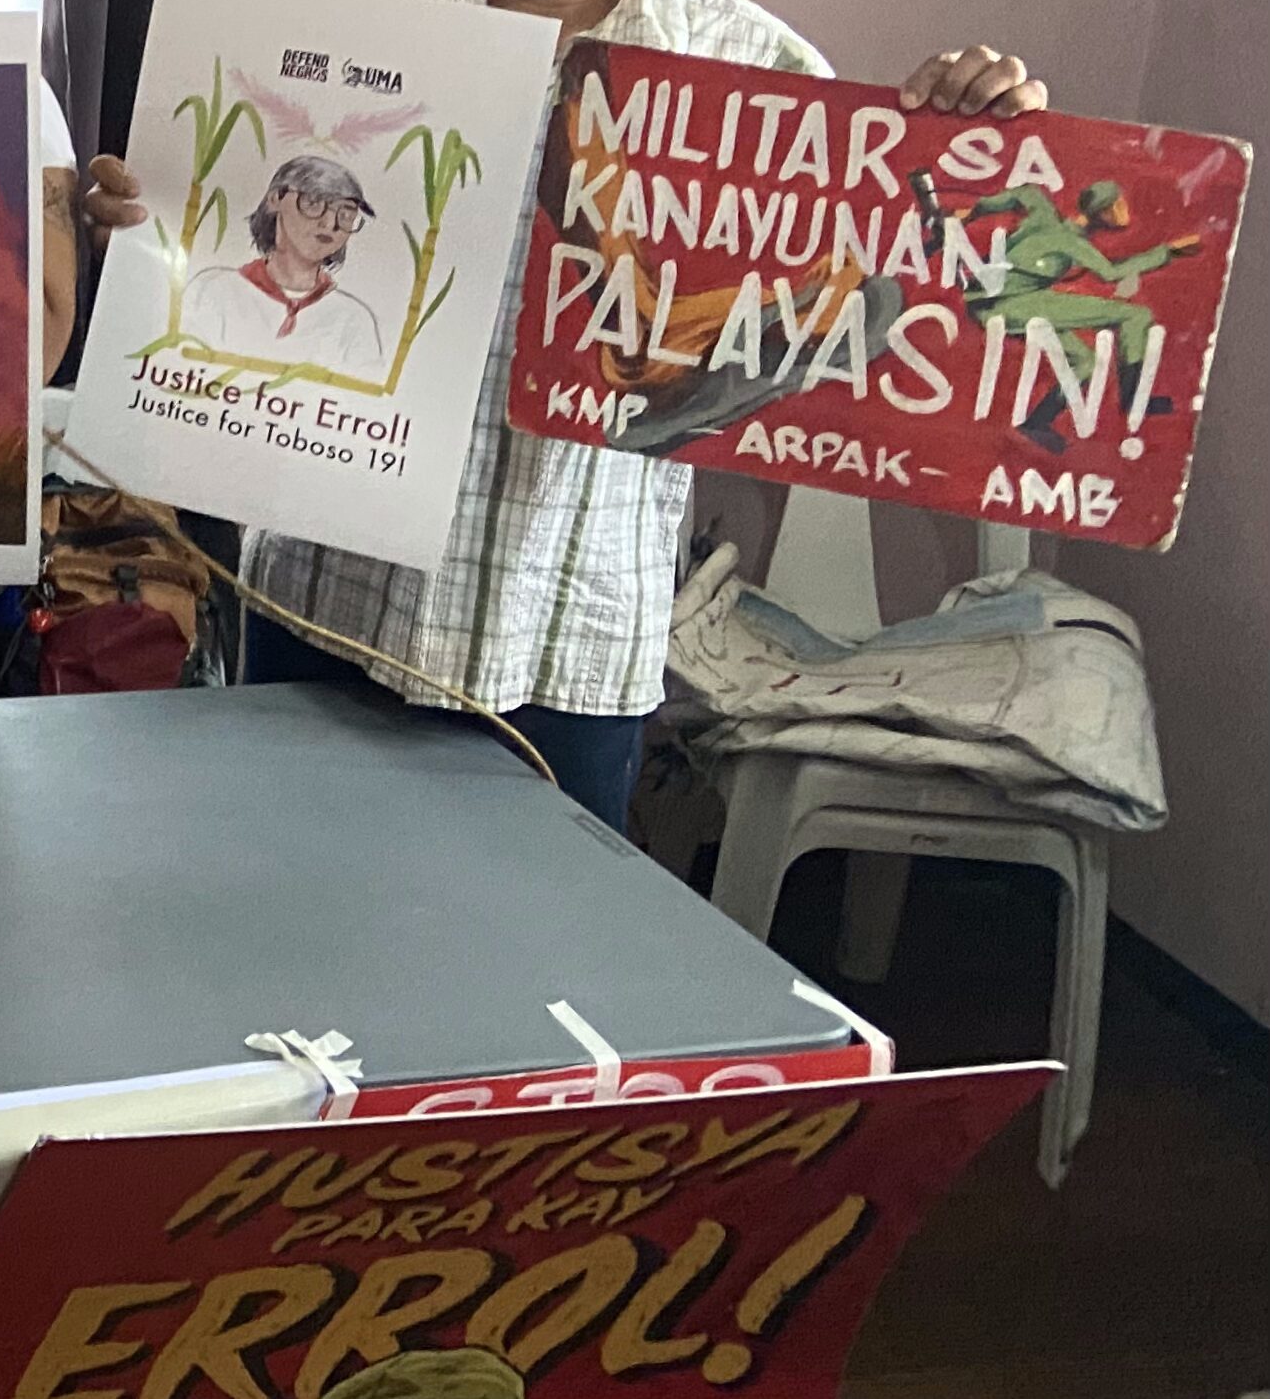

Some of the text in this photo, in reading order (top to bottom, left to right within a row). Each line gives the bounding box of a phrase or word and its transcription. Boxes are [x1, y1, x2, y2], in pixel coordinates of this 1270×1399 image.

[280, 64, 329, 83] NEGROS
[281, 49, 330, 69] DEFEND
[364, 66, 403, 94] UMA
[576, 69, 1066, 200] MILITAR SA
[561, 159, 1016, 300] KANAYUNAN
[130, 354, 413, 448] Justice for Errol!
[542, 241, 1167, 461] PALAYASIN!
[128, 389, 407, 477] Justice for Toboso 19!
[545, 381, 649, 437] KMP
[979, 465, 1124, 527] AMB
[165, 1098, 862, 1232] HUSTISYA
[270, 1181, 677, 1254] PARA KAY
[14, 1194, 867, 1399] ERROL!
